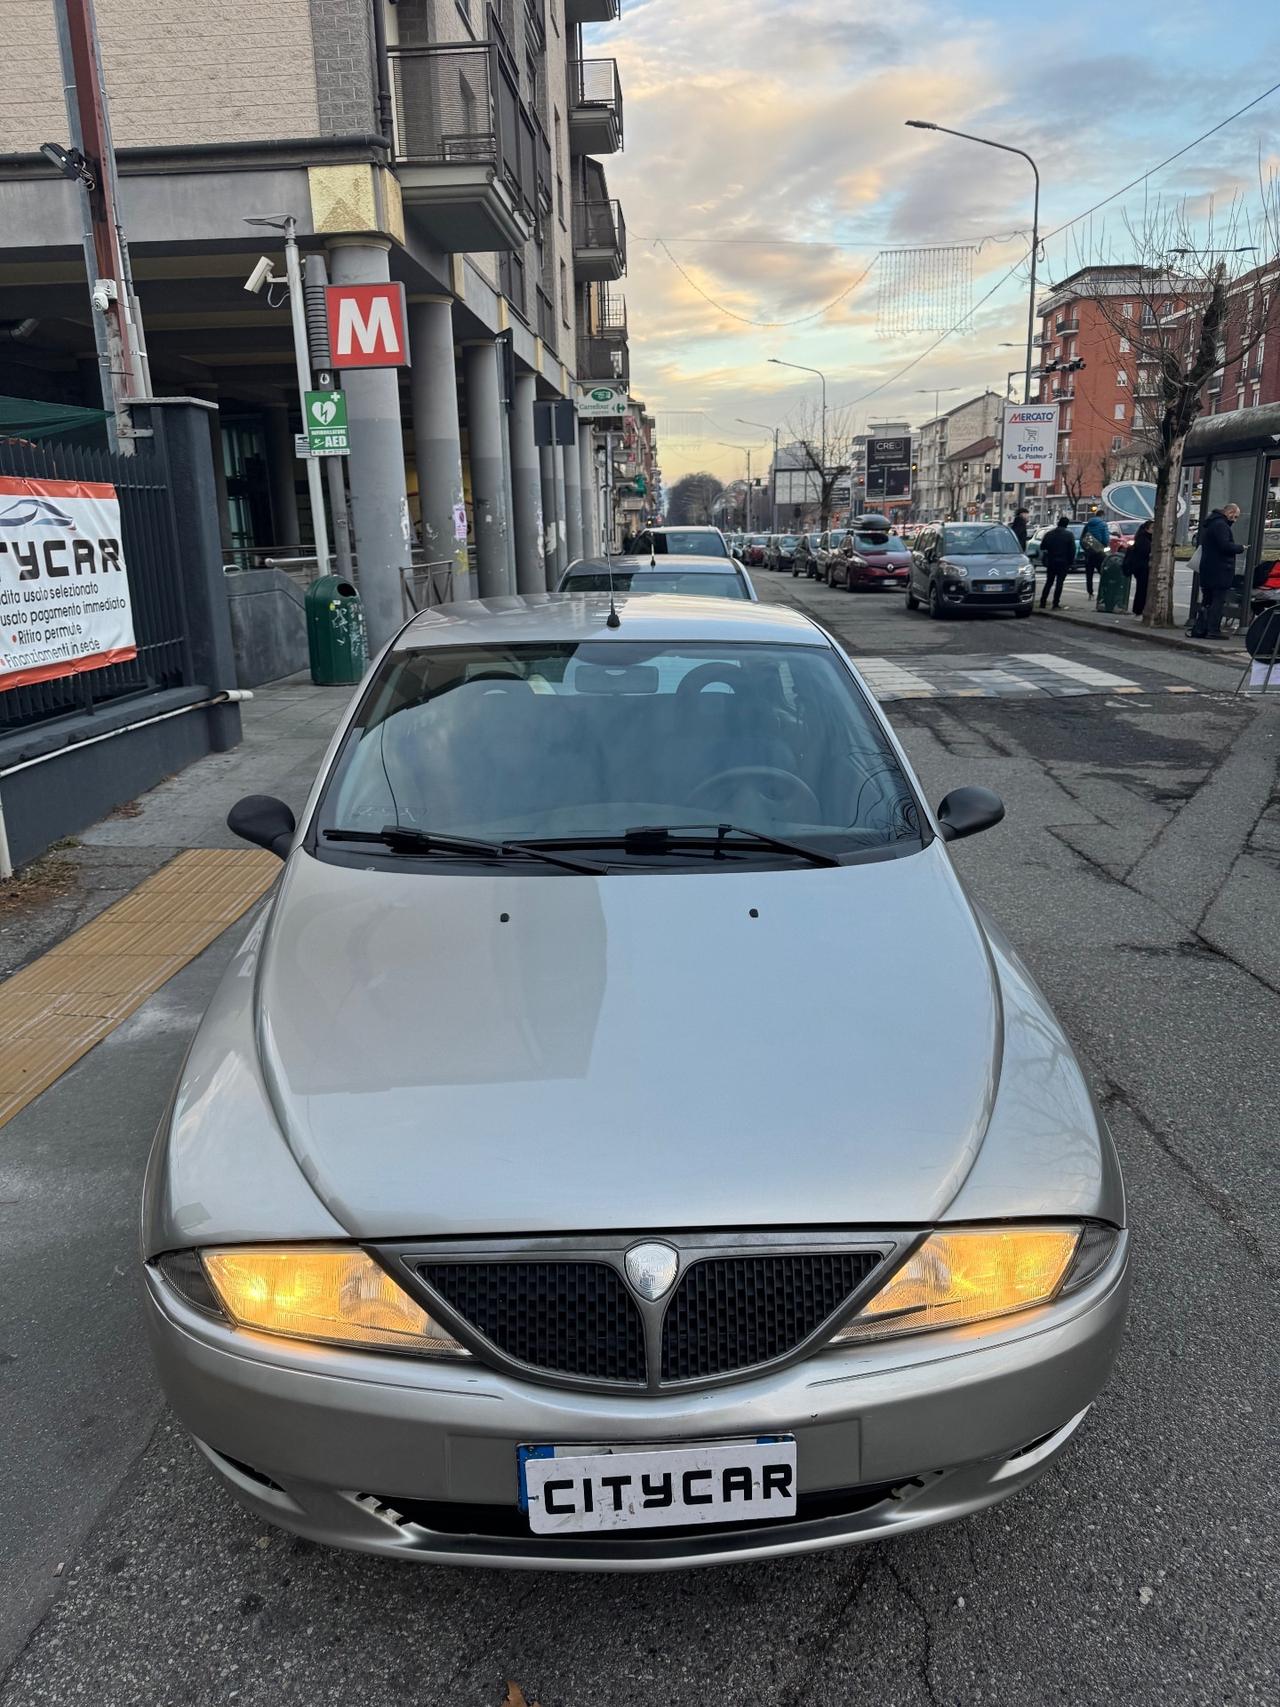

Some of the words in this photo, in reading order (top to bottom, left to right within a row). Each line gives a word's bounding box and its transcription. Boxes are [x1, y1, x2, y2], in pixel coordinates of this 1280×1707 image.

[337, 296, 400, 354] M
[324, 435, 347, 447] AED
[1017, 444, 1044, 452] Torino
[0, 588, 20, 605] dita
[24, 587, 49, 602] usato
[50, 582, 99, 599] selezionato
[1, 610, 27, 626] usato
[30, 602, 81, 625] pagamento
[83, 596, 126, 614] immediato
[18, 629, 41, 645] Ritiro
[45, 622, 82, 643] permute
[4, 643, 70, 668] Finanziamenti
[71, 642, 79, 656] in
[80, 637, 100, 653] sede
[543, 1463, 793, 1515] CITYCAR
